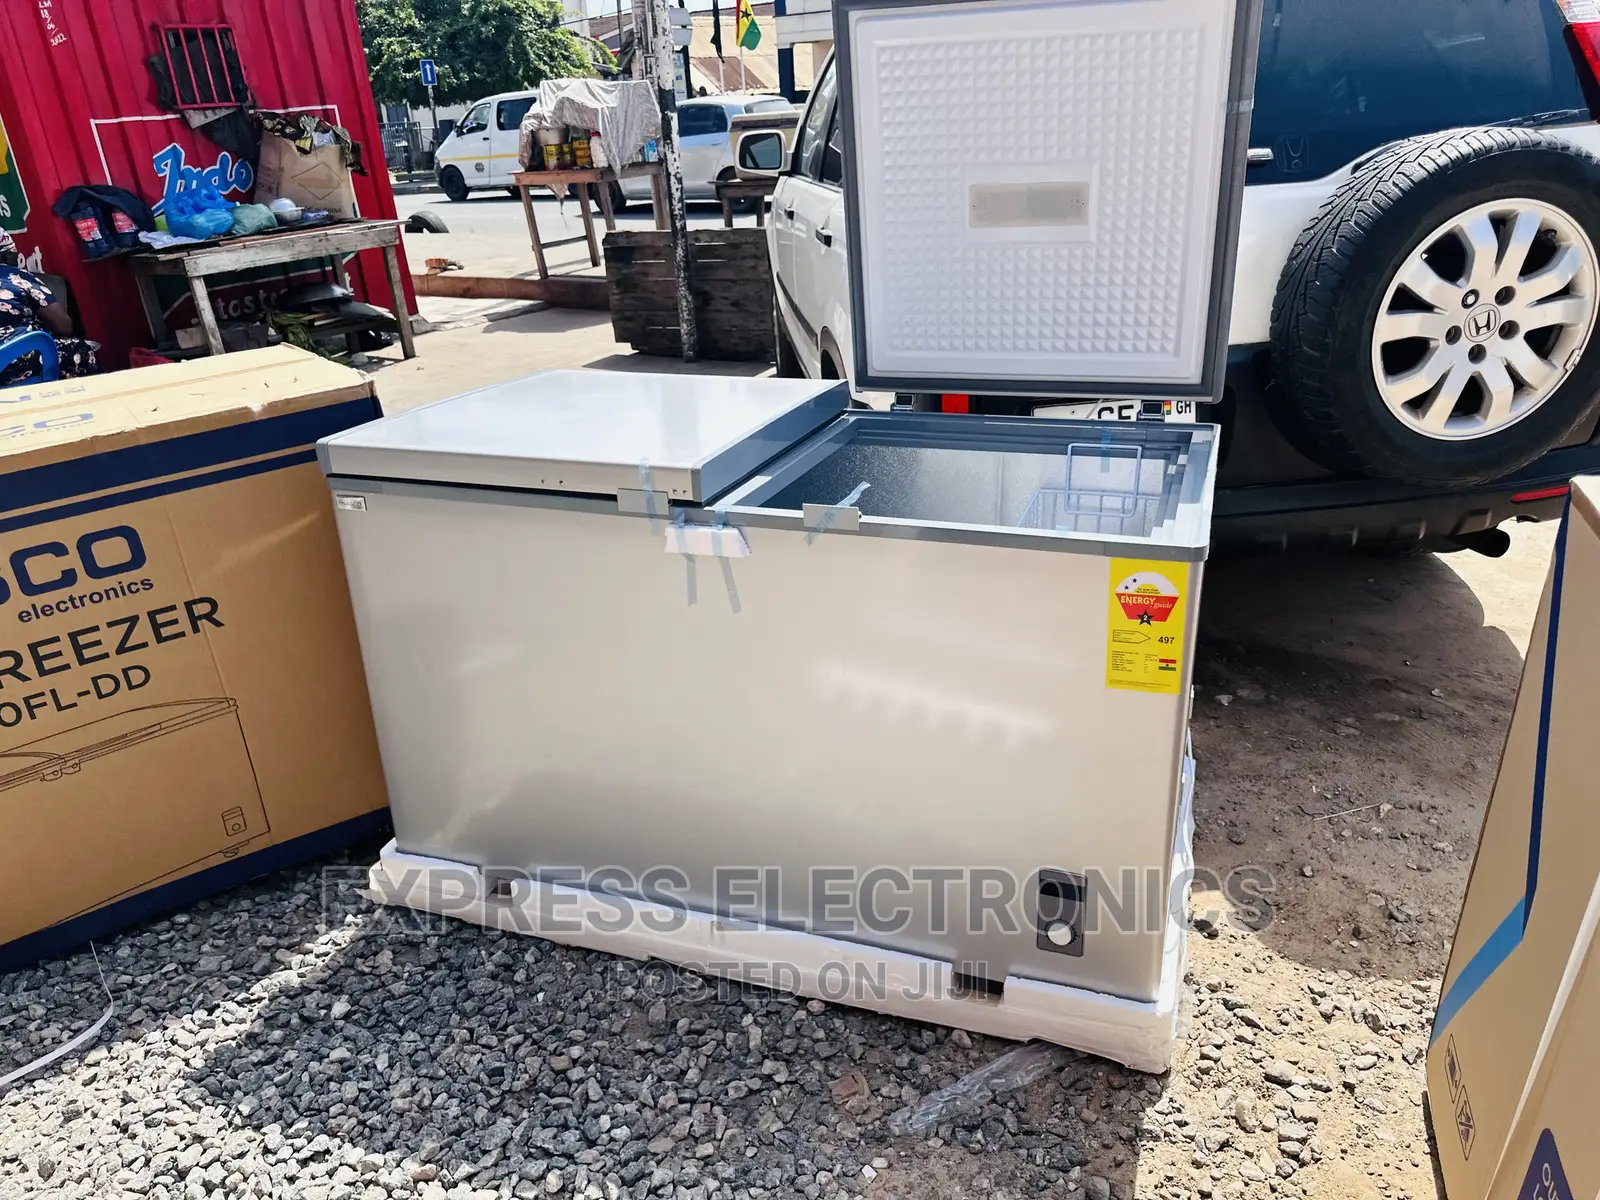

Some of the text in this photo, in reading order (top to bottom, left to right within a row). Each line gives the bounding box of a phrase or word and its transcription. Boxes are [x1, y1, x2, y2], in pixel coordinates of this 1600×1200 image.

[1175, 400, 1192, 414] GH
[0, 525, 147, 606] CO
[18, 577, 154, 623] electronics
[1120, 594, 1173, 609] ENERGY guide
[1158, 636, 1175, 644] 497
